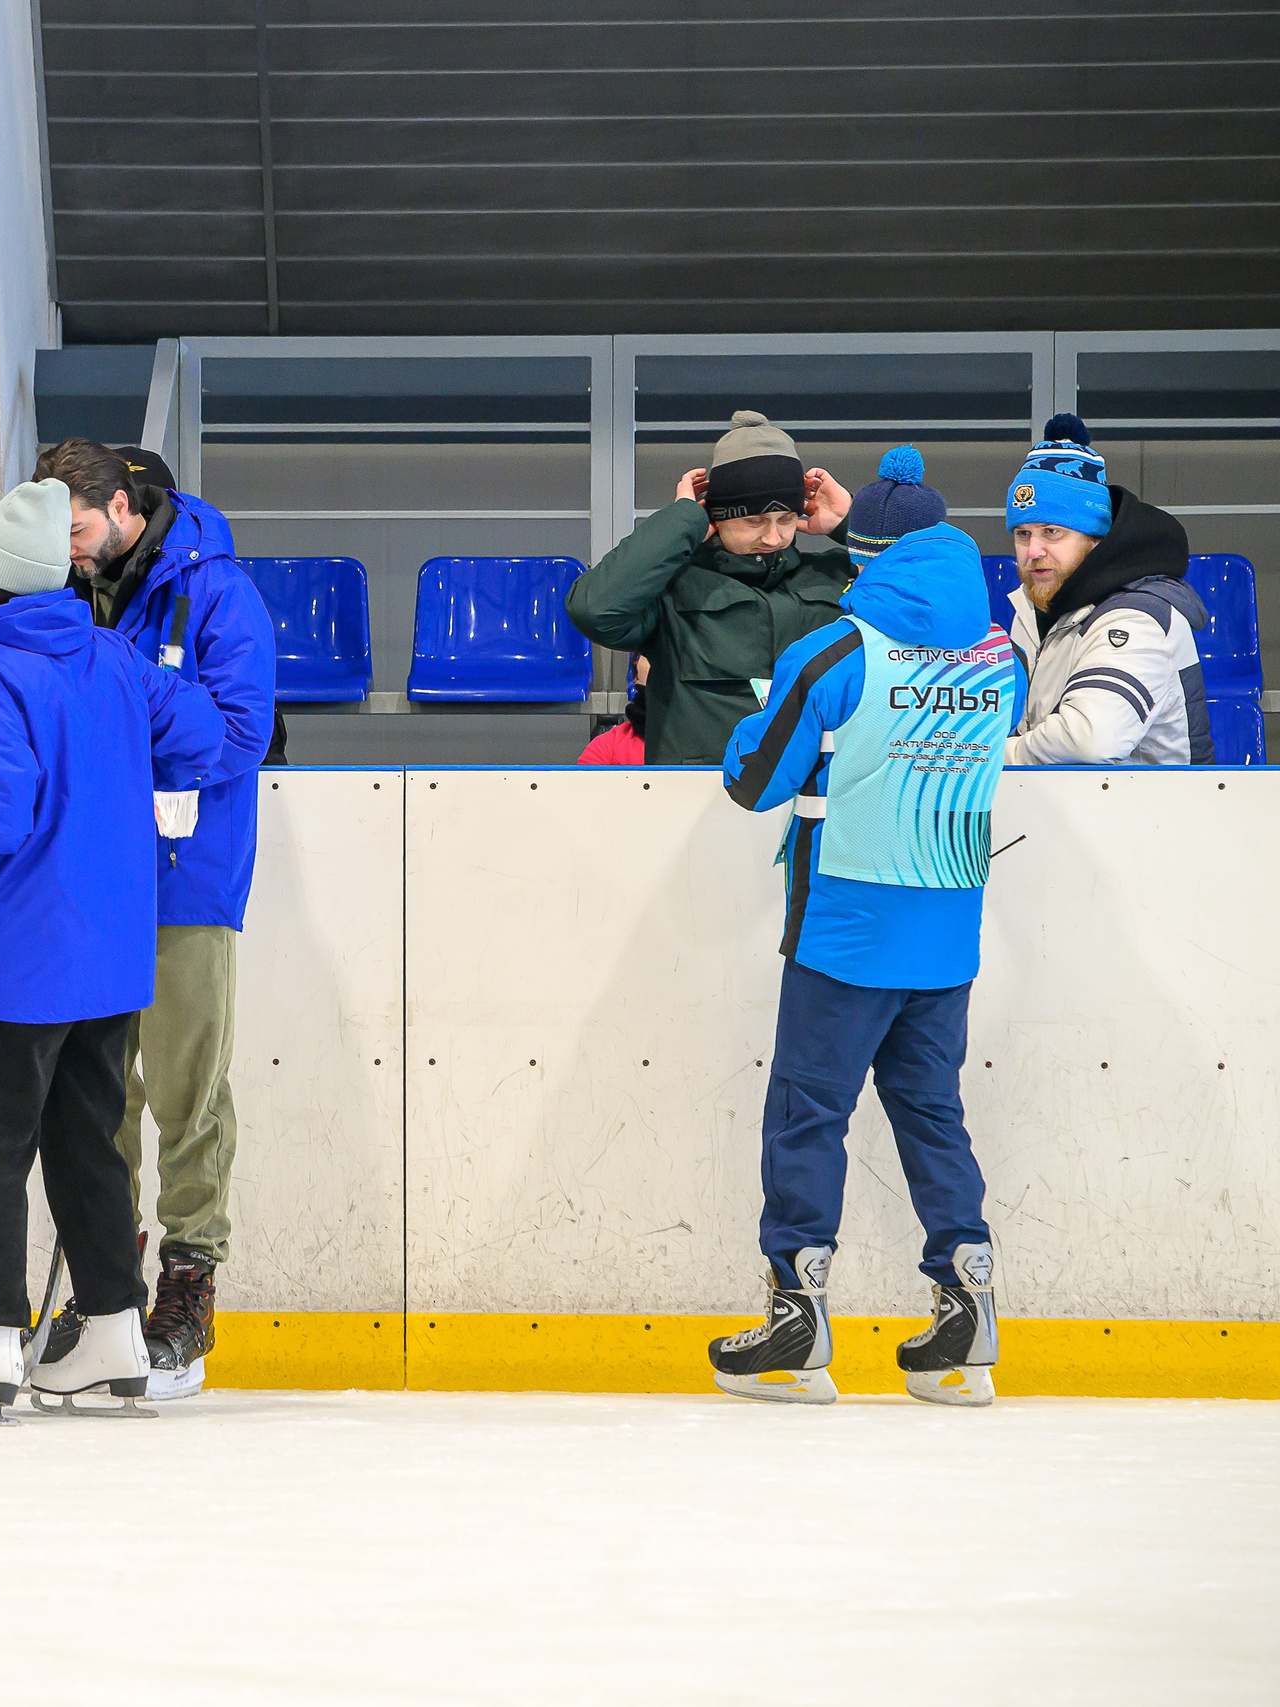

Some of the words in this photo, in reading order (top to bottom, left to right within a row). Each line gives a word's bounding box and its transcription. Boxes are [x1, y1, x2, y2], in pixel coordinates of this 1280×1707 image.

[887, 649, 956, 662] ACTIVE
[958, 650, 998, 665] LIFE
[889, 686, 1000, 715] СУДЬЯ
